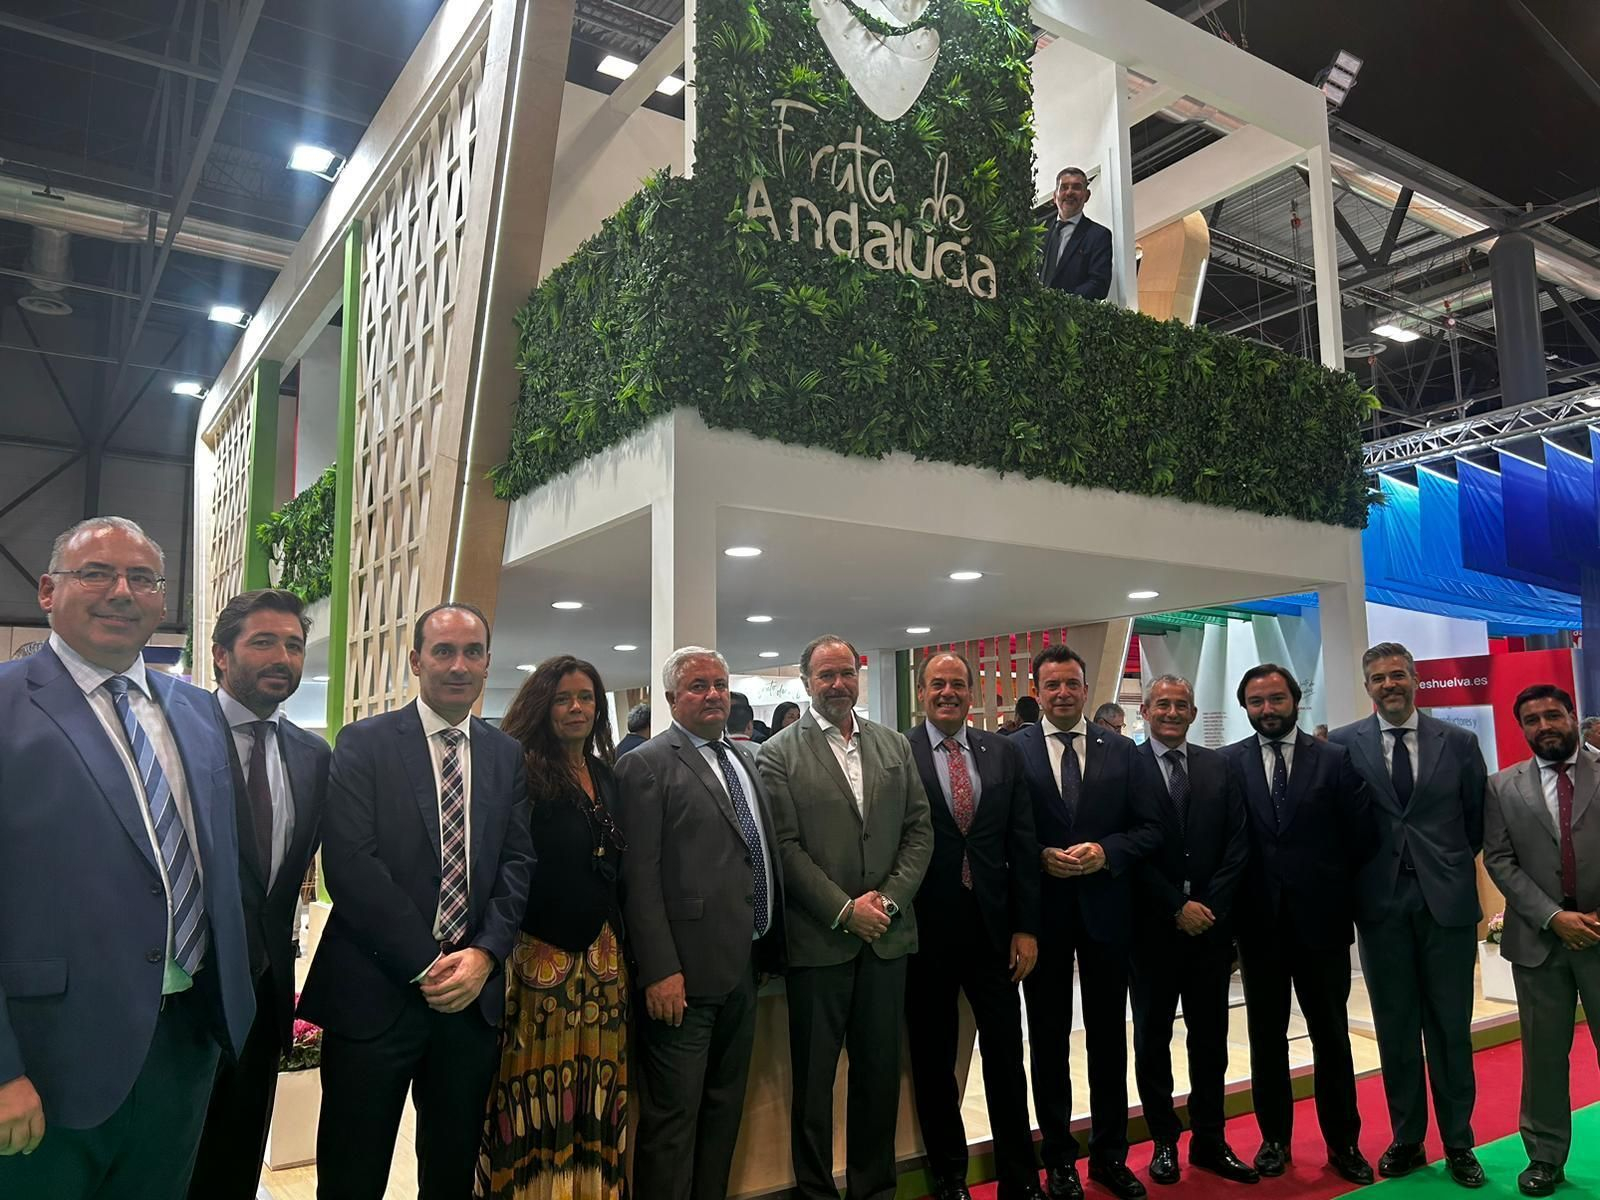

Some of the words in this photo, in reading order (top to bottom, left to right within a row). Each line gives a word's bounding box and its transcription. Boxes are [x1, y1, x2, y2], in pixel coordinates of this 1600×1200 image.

[771, 99, 897, 212] Fruta
[920, 151, 973, 233] de
[1418, 677, 1488, 689] eshuelva.es
